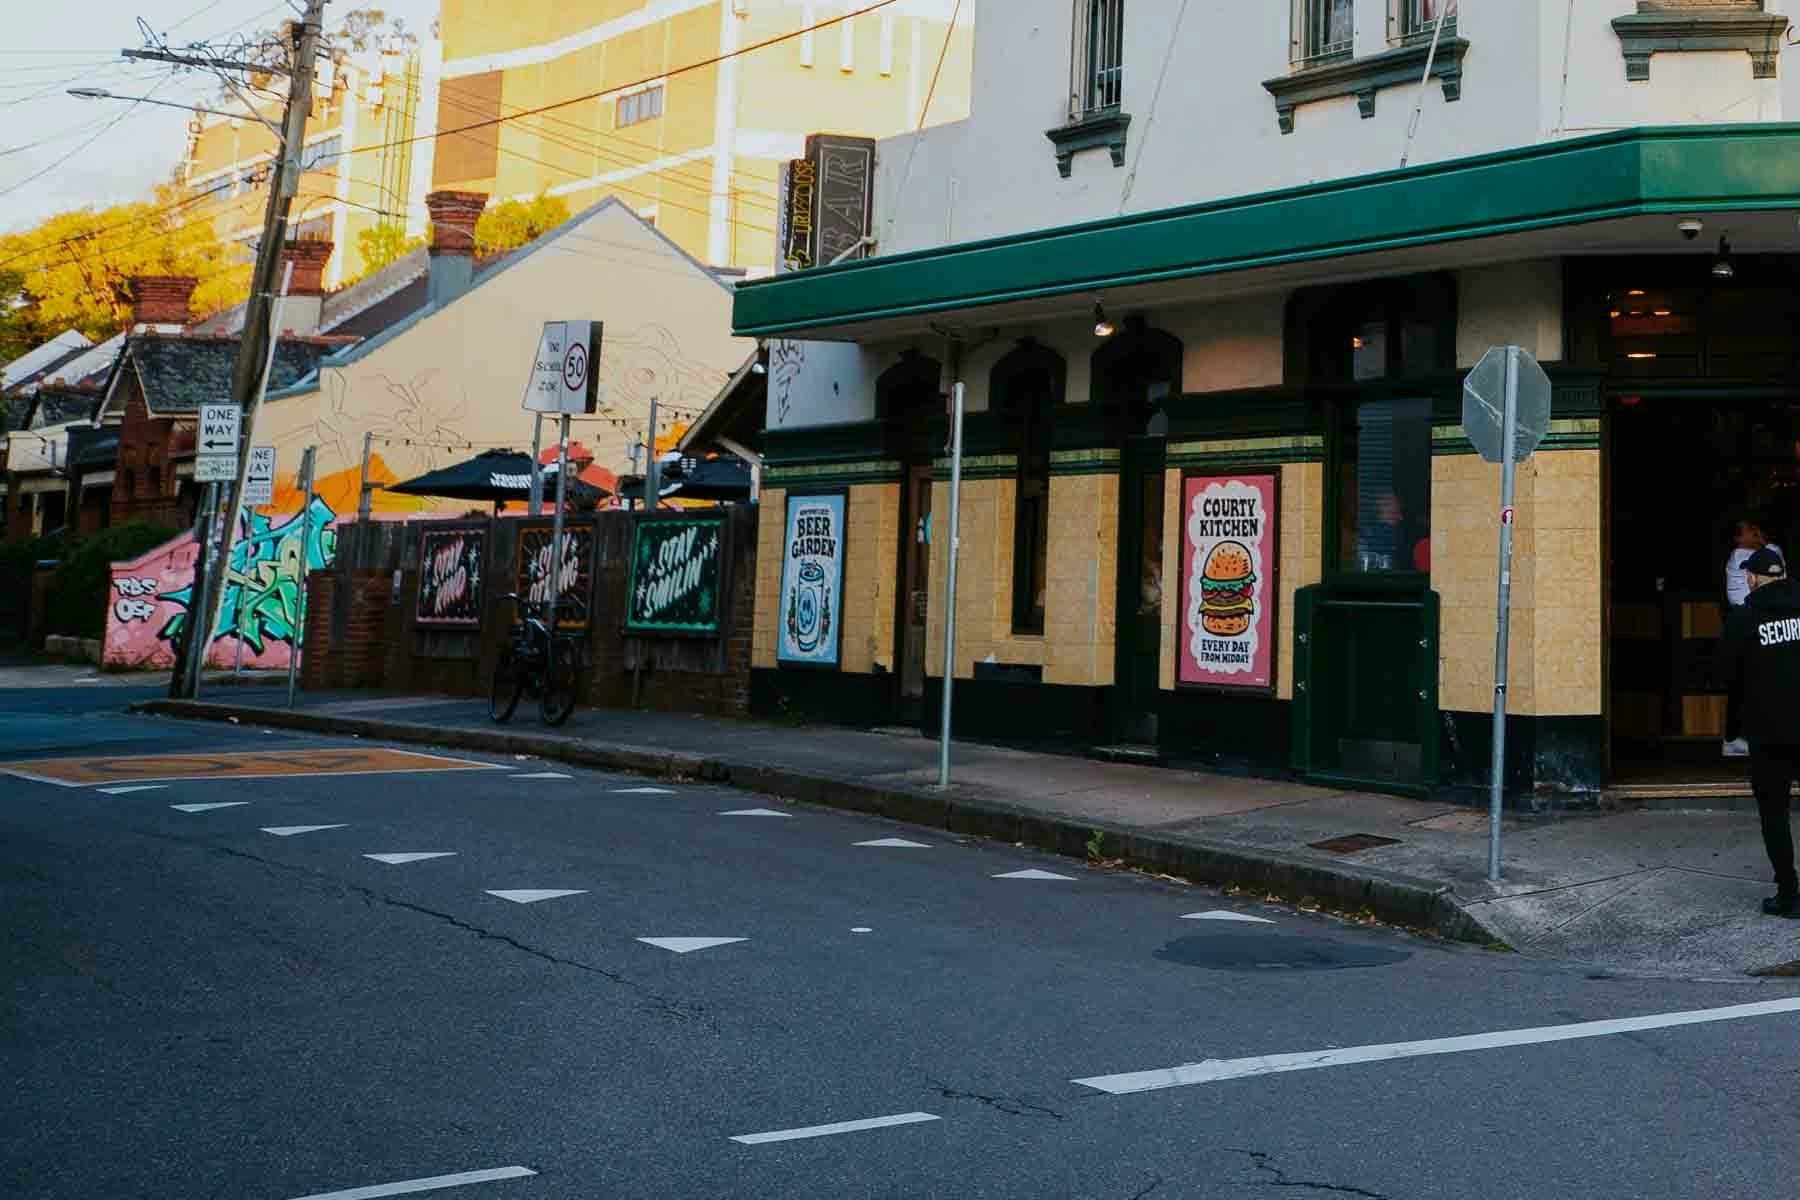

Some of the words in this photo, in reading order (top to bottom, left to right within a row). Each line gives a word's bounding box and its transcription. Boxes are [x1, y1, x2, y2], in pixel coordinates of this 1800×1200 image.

[567, 355, 584, 378] 50
[207, 409, 233, 420] ONE
[204, 424, 234, 435] WAY
[1203, 498, 1256, 517] COURTY
[797, 516, 830, 538] BEER
[1200, 519, 1258, 537] KITCHEN
[537, 533, 571, 579] STY
[656, 526, 697, 577] STAY
[791, 538, 836, 559] GARDEN
[1202, 639, 1230, 652] EVERY
[1232, 641, 1250, 653] DAY
